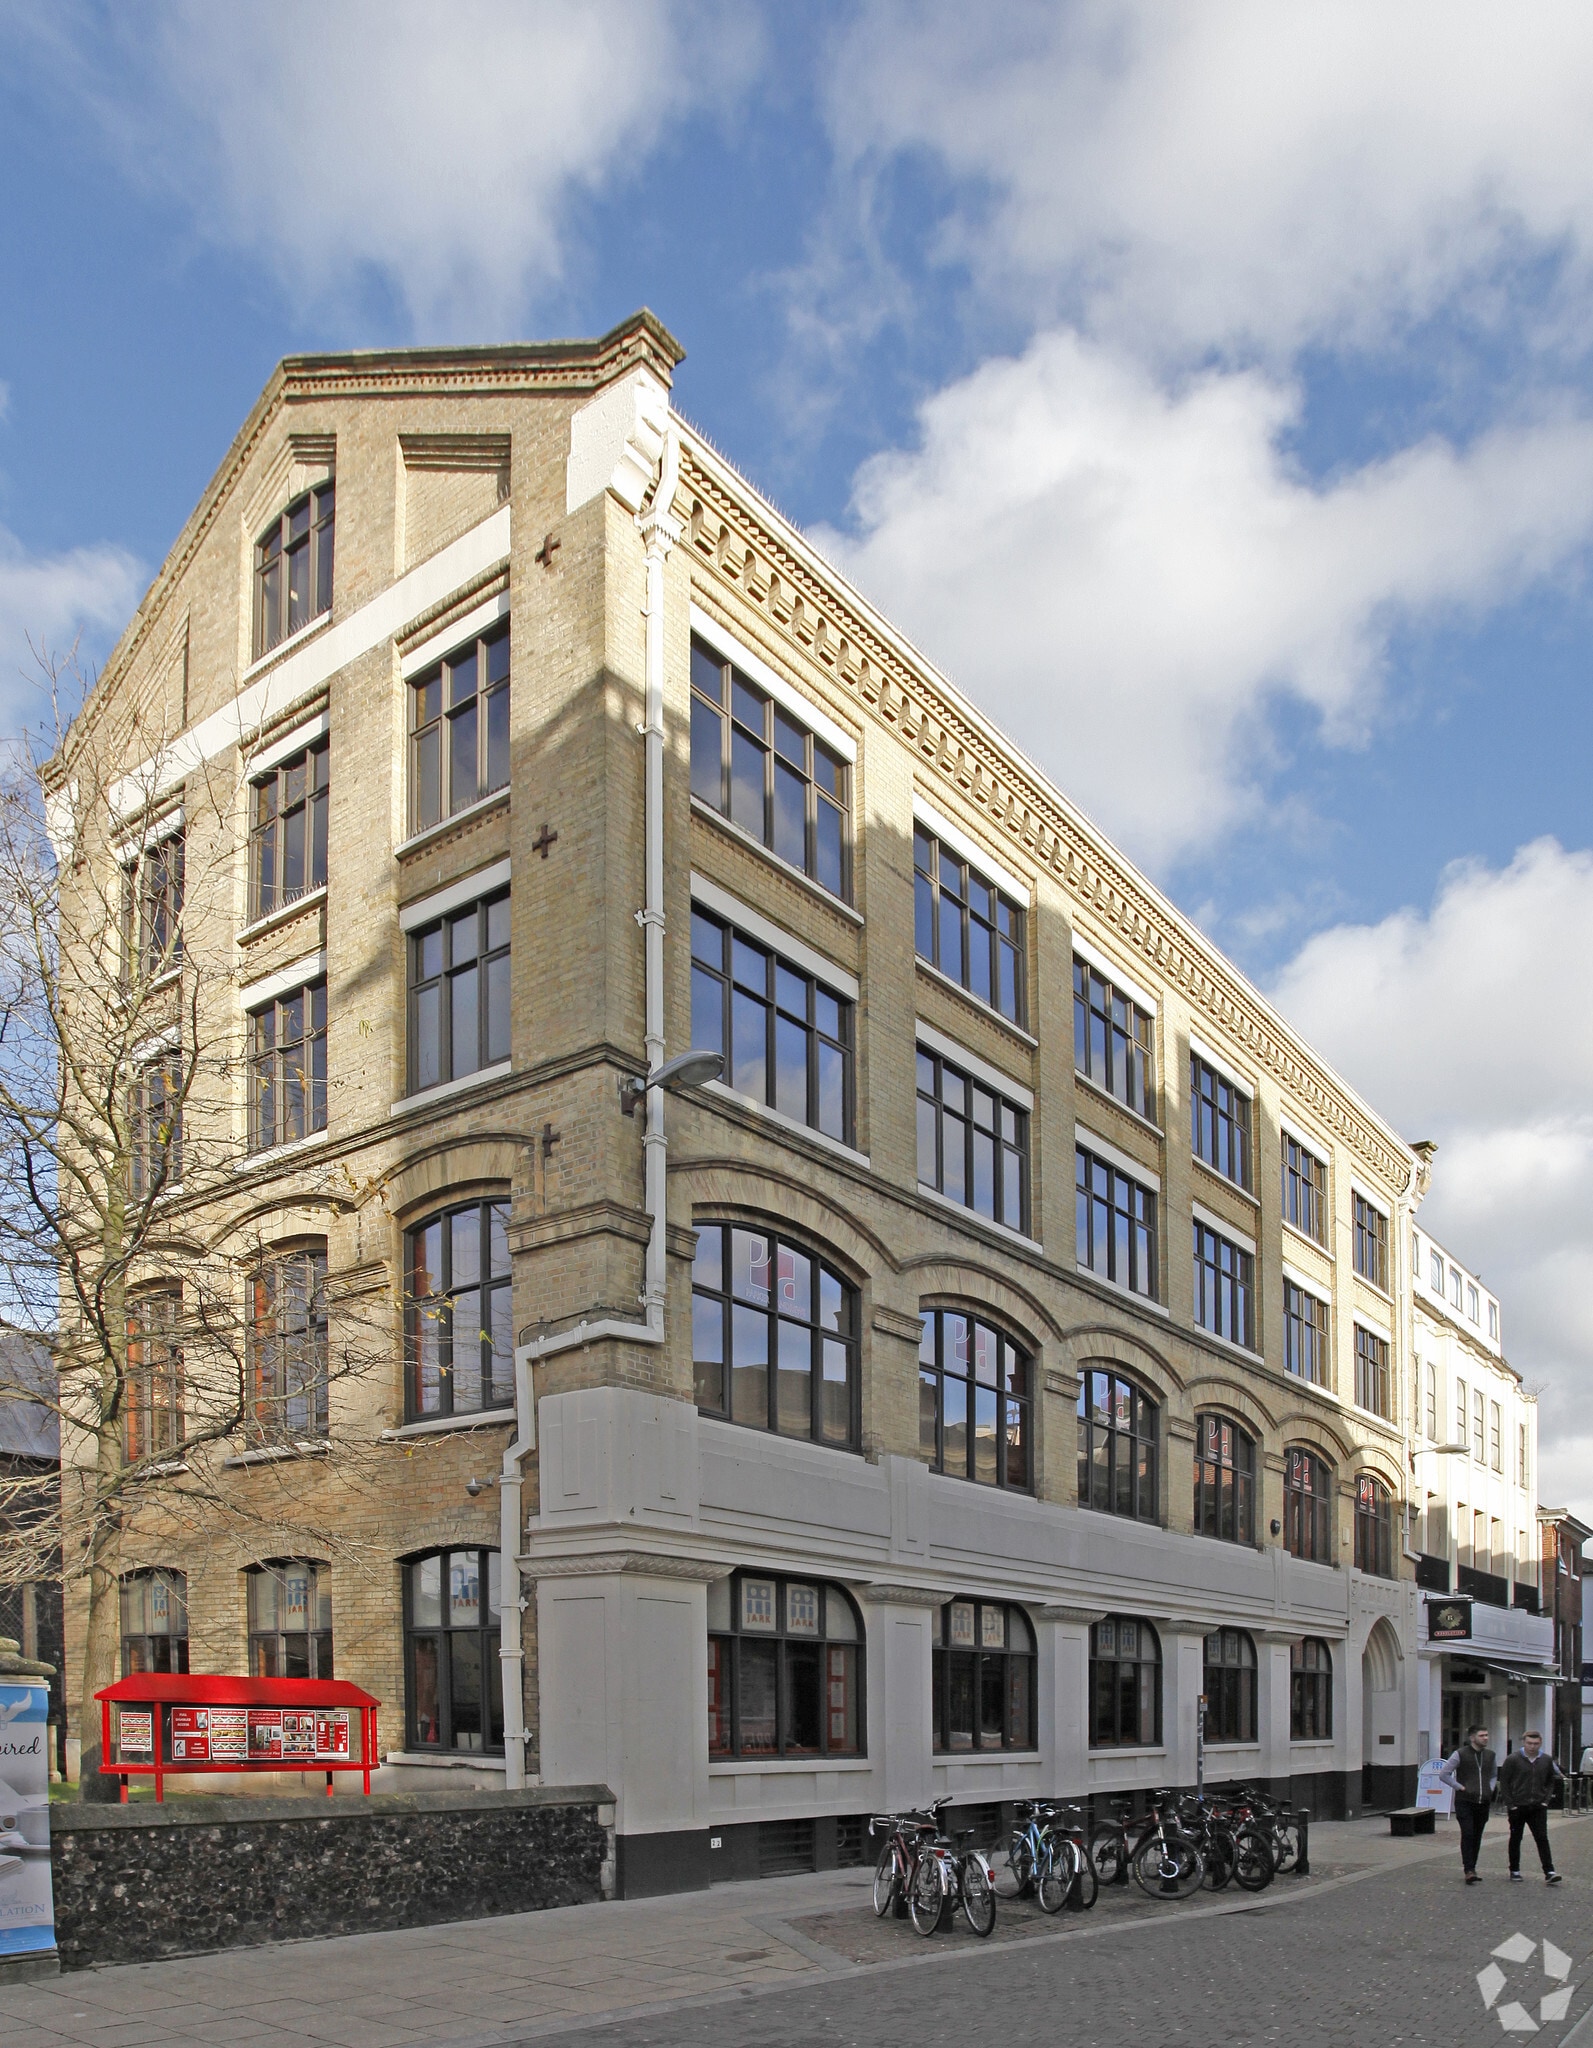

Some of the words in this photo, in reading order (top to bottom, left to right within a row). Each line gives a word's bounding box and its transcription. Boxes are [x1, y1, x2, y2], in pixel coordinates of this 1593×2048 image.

[453, 1598, 478, 1610] JARK
[746, 1613, 771, 1624] JARK
[790, 1617, 814, 1628] JARK
[0, 1736, 41, 1756] ired
